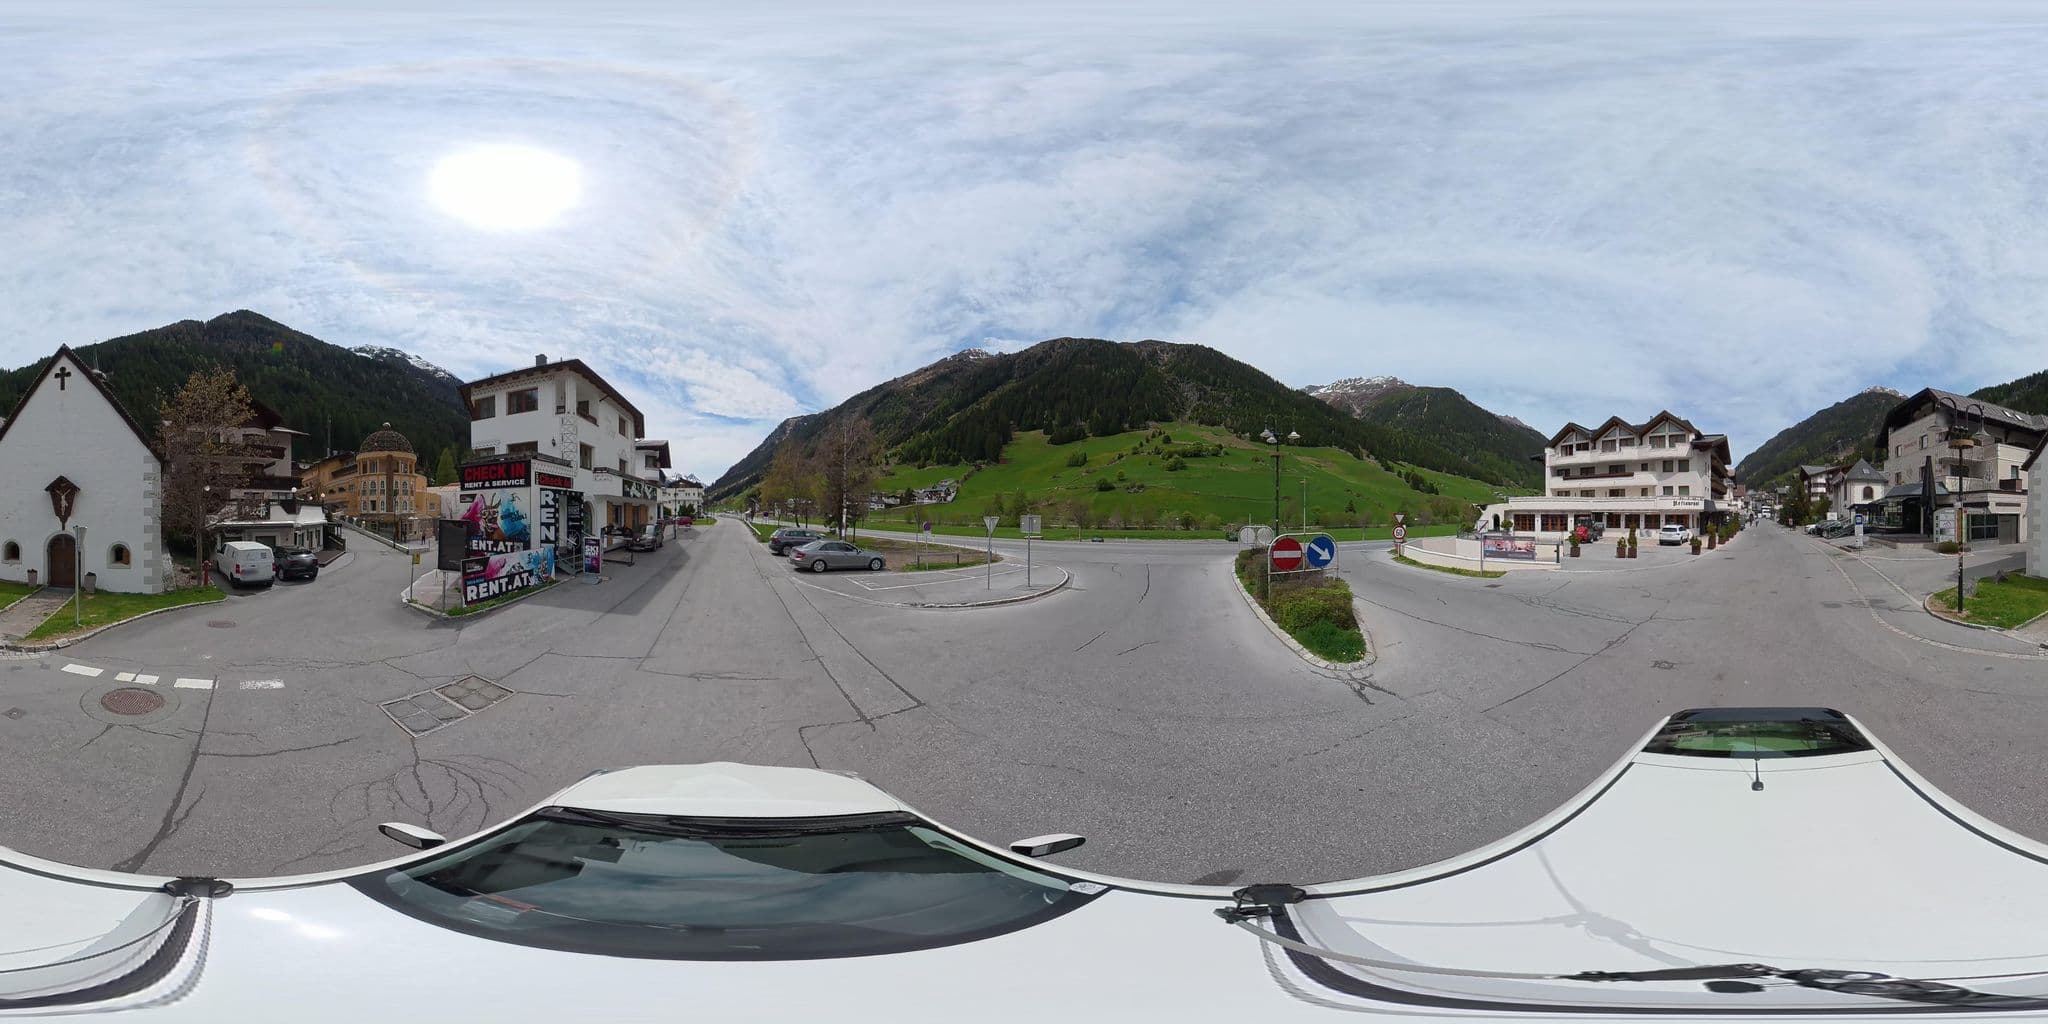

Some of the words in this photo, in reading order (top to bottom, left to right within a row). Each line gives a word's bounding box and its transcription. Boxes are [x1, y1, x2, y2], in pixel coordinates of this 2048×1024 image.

[464, 463, 508, 481] CHECK
[511, 462, 525, 478] IN
[492, 479, 526, 487] SERVICE
[470, 539, 513, 552] ENT.AT
[466, 572, 529, 602] RENT.AT
